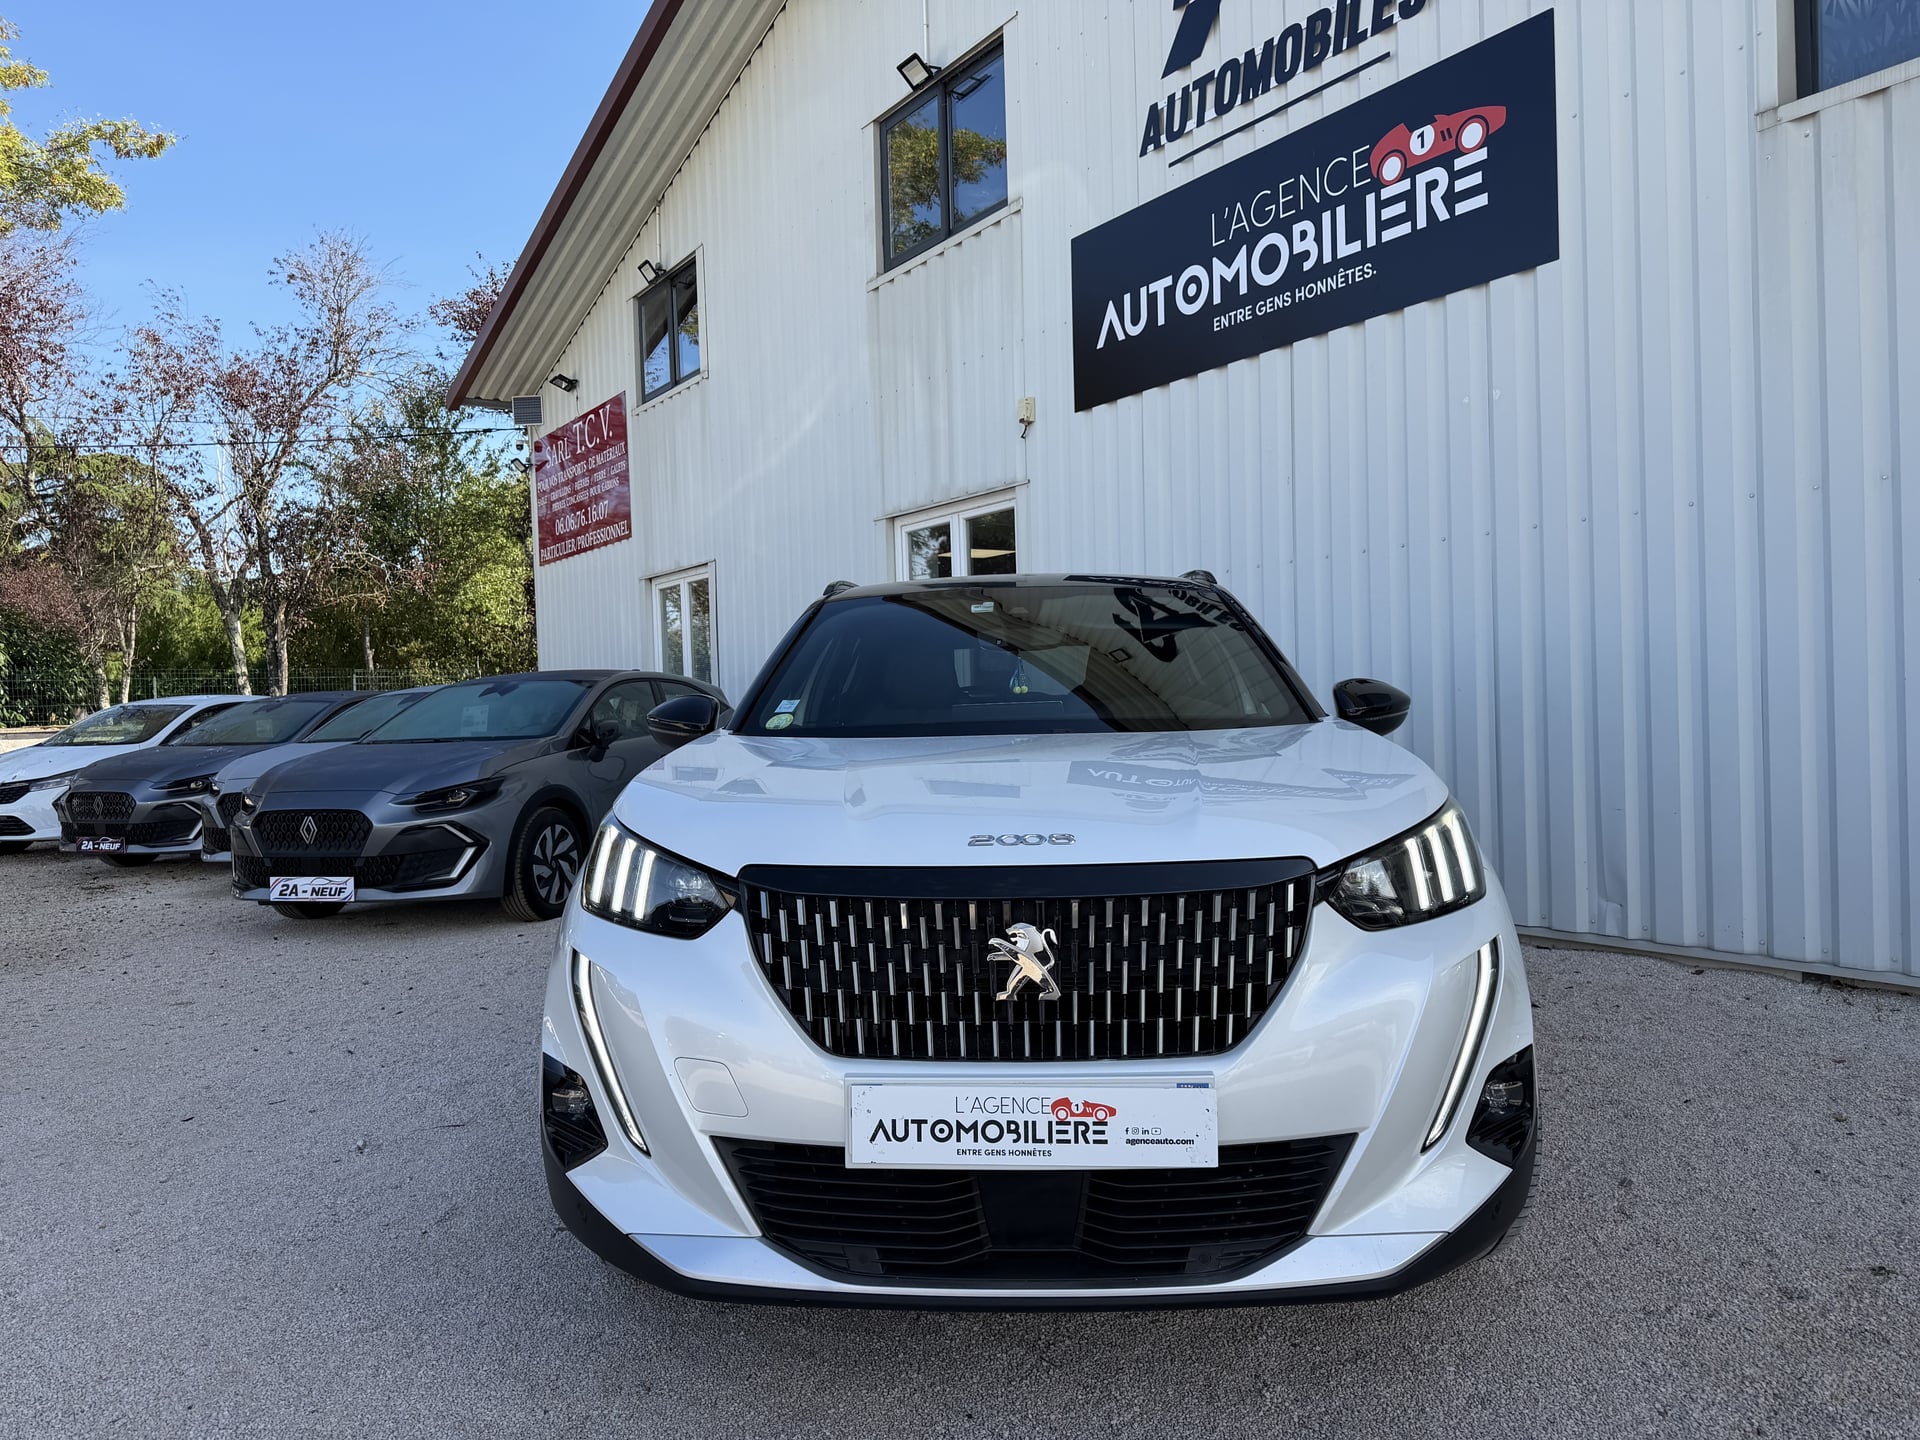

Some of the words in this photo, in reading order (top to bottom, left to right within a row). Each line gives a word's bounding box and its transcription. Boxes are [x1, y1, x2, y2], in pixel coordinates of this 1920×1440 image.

[1212, 144, 1371, 247] L'AGENCE
[1213, 305, 1253, 331] ENTRE
[1255, 292, 1292, 316] GENS
[1295, 263, 1377, 303] HONNÊTES.
[546, 437, 571, 469] SARL
[588, 456, 596, 470] DE
[555, 500, 609, 536] 06.06.76.16.07
[540, 519, 630, 562] PARTICULIER/PROFESSIONNEL
[81, 840, 93, 850] 2A
[967, 833, 1076, 847] 2008
[278, 884, 298, 897] 2A
[310, 887, 347, 897] NEUF
[955, 1096, 1052, 1114] L'AGENCE
[1125, 1137, 1195, 1146] agenceauto.com
[956, 1148, 983, 1156] ENTRE
[984, 1148, 1007, 1157] GENS
[1008, 1147, 1052, 1157] HONNÊTES
